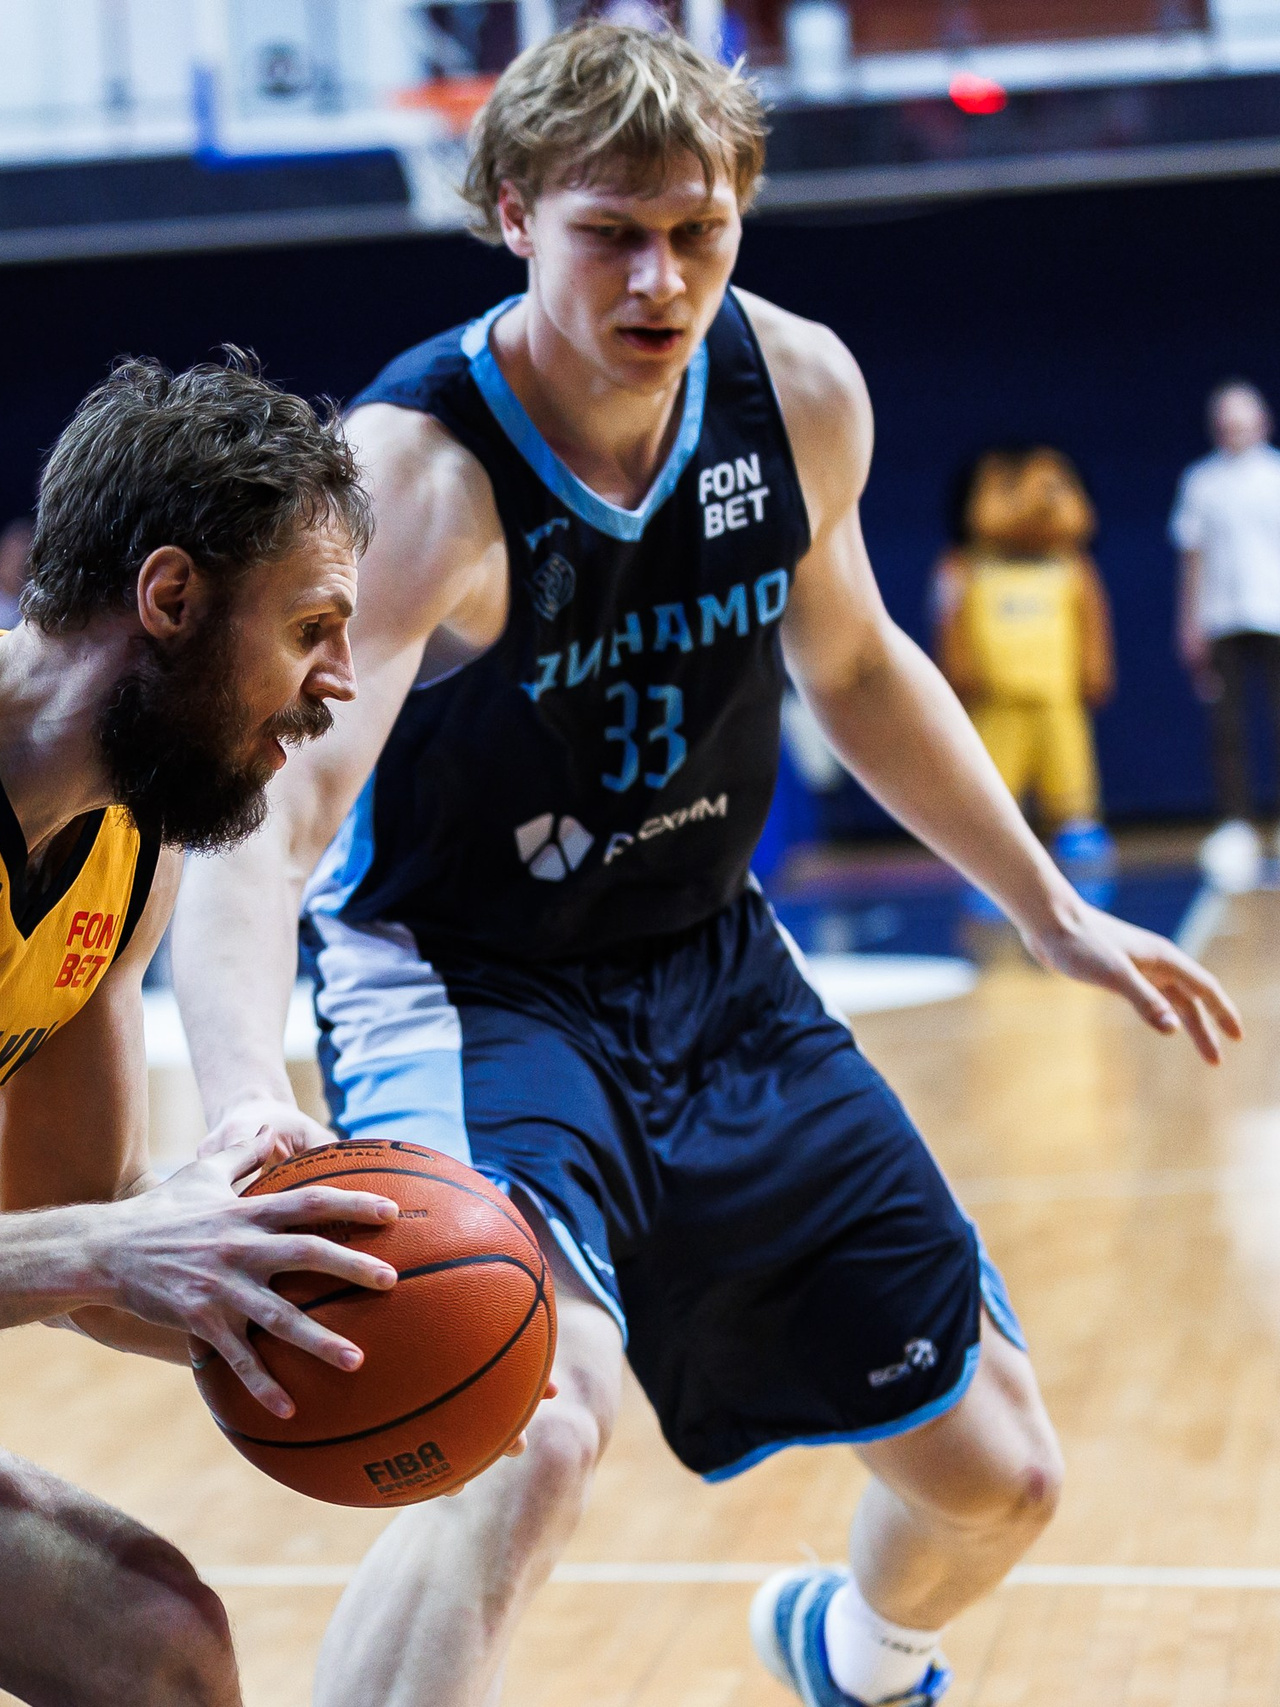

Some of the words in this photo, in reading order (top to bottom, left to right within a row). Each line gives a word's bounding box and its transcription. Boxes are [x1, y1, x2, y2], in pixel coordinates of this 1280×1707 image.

[699, 452, 762, 505] FON
[704, 485, 770, 539] BET
[600, 680, 687, 793] 33
[65, 910, 120, 949] FON
[53, 953, 108, 988] BET
[363, 1441, 446, 1486] FIBA
